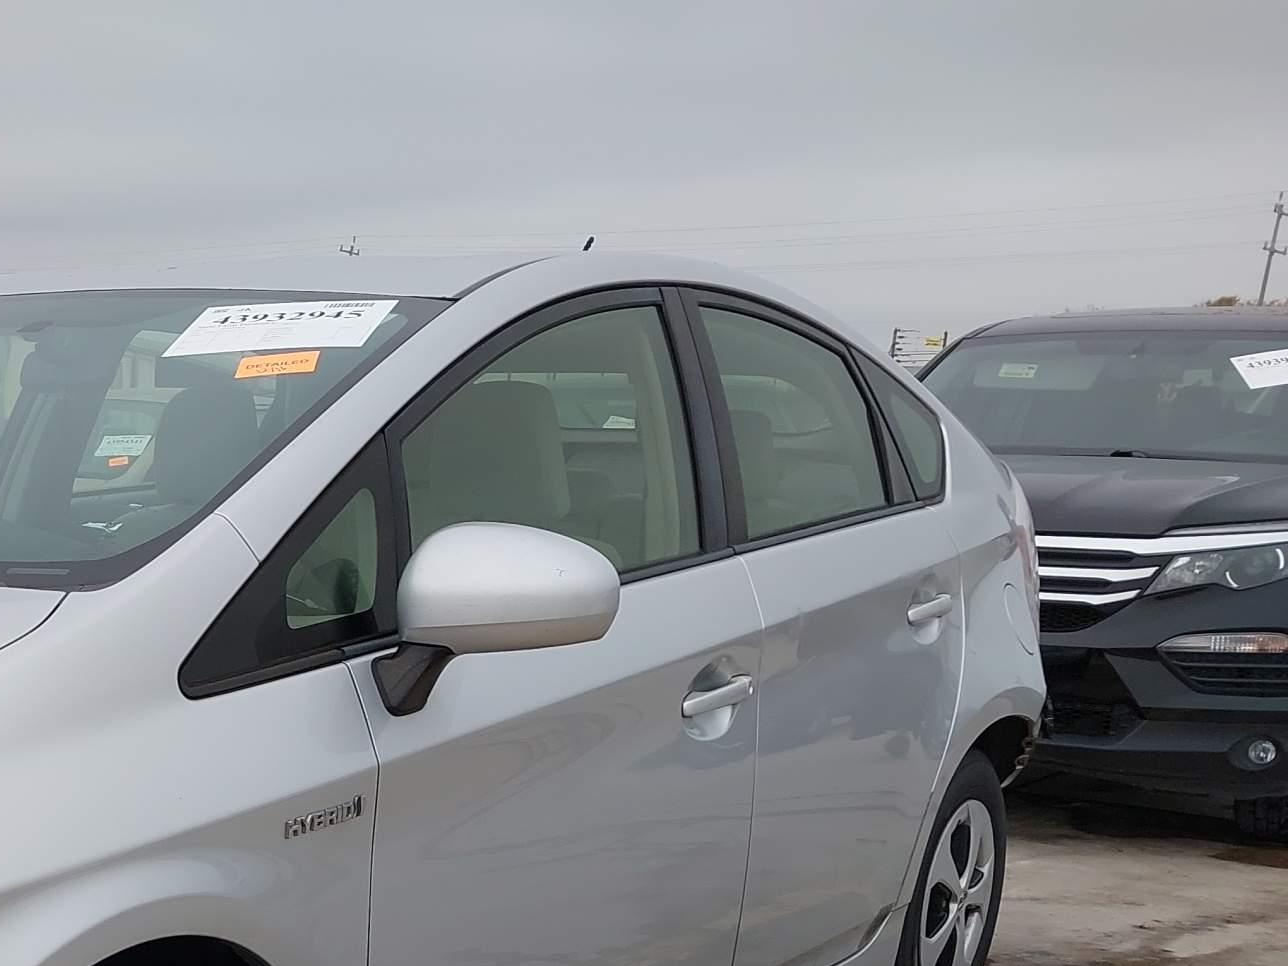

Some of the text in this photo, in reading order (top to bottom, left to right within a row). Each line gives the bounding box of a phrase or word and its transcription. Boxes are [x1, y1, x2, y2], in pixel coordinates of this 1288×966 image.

[213, 308, 366, 326] 43932945
[245, 357, 310, 370] DETAILED
[285, 794, 364, 839] HYBRID
